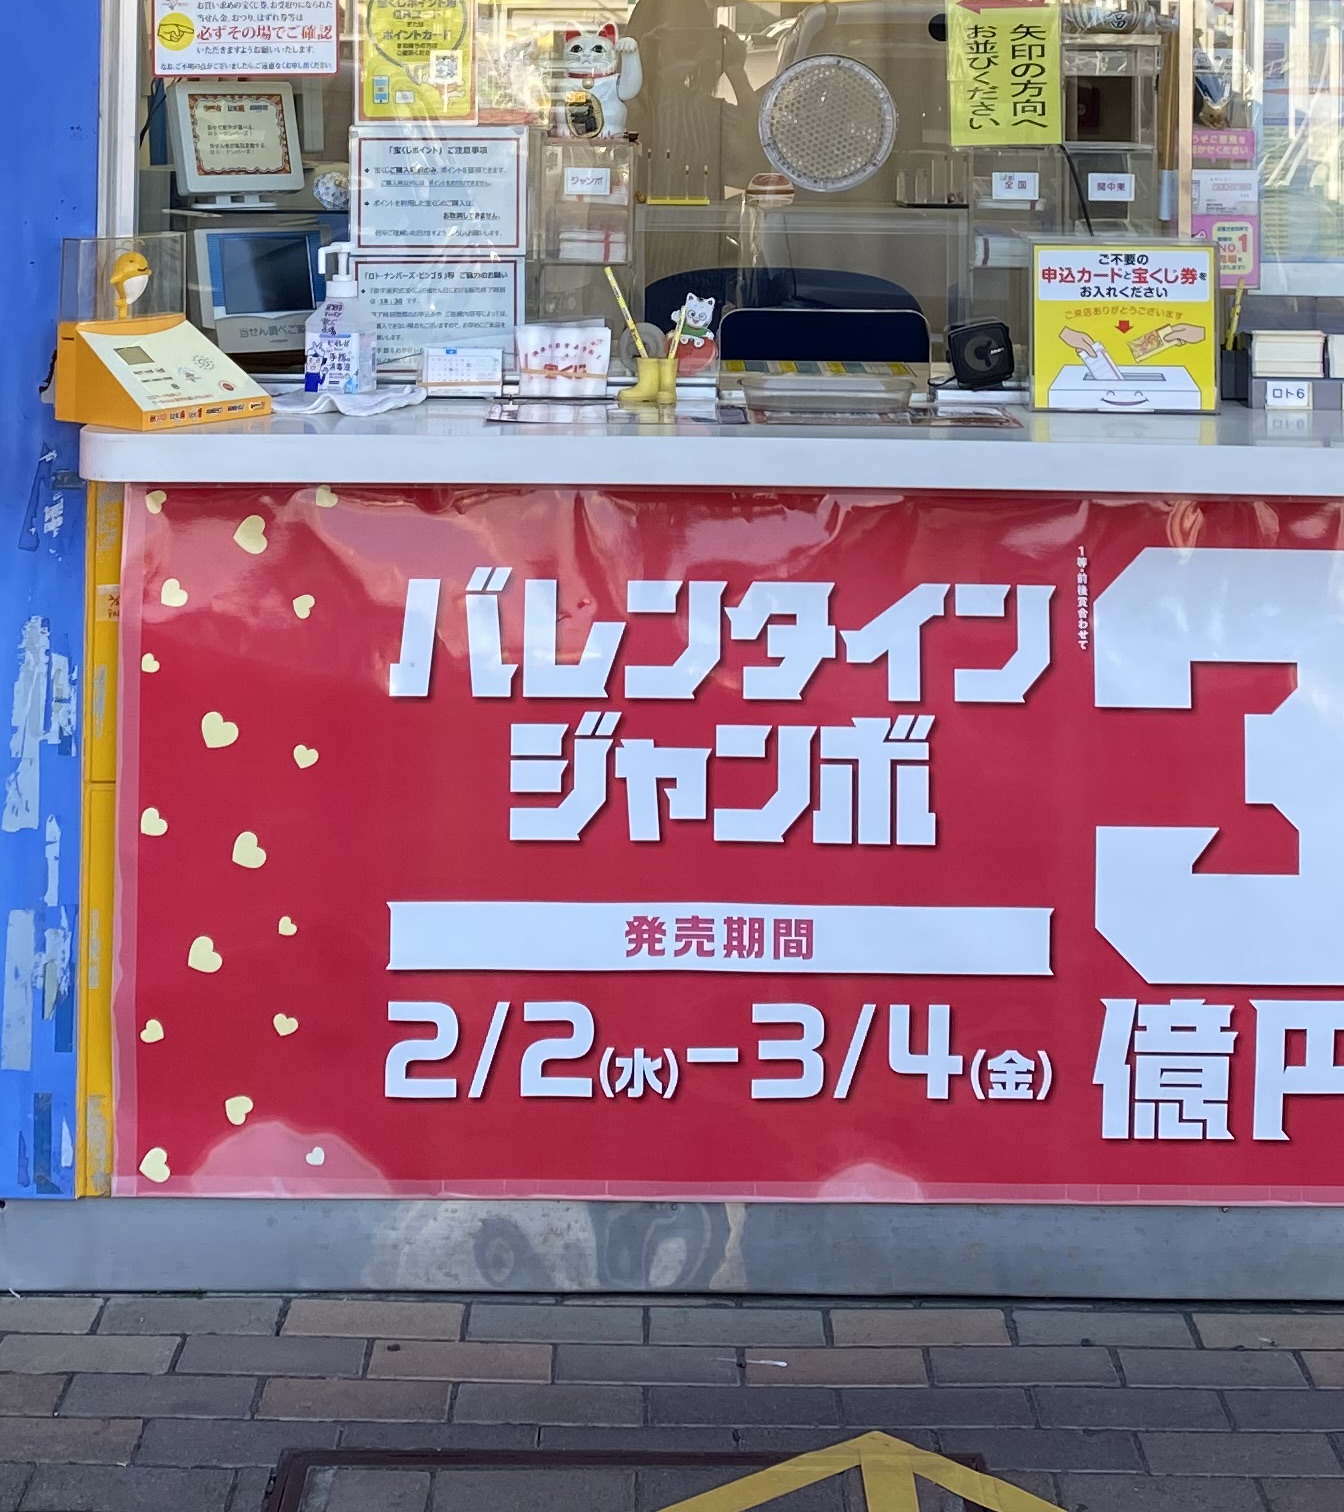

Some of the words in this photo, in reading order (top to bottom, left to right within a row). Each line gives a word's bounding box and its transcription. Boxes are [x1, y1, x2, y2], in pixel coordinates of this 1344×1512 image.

[197, 25, 332, 40] 必ずその場でご確認
[966, 24, 1000, 130] お並びください
[1010, 24, 1048, 129] 矢印の方向へ
[571, 176, 604, 185] ジャンボ
[1005, 180, 1027, 189] 全国
[1098, 254, 1148, 264] ご不要の
[1042, 267, 1207, 284] 申込カードと宝くじ券を
[1080, 287, 1168, 298] お入れください
[1064, 306, 1183, 320] ご来店ありがとうございます
[1273, 388, 1305, 399] ロト6
[1076, 545, 1089, 650] 1等・前後賞合わせて
[387, 565, 1055, 706] バレンタイン
[509, 711, 939, 848] ジャンボ
[622, 911, 816, 964] 発売期間
